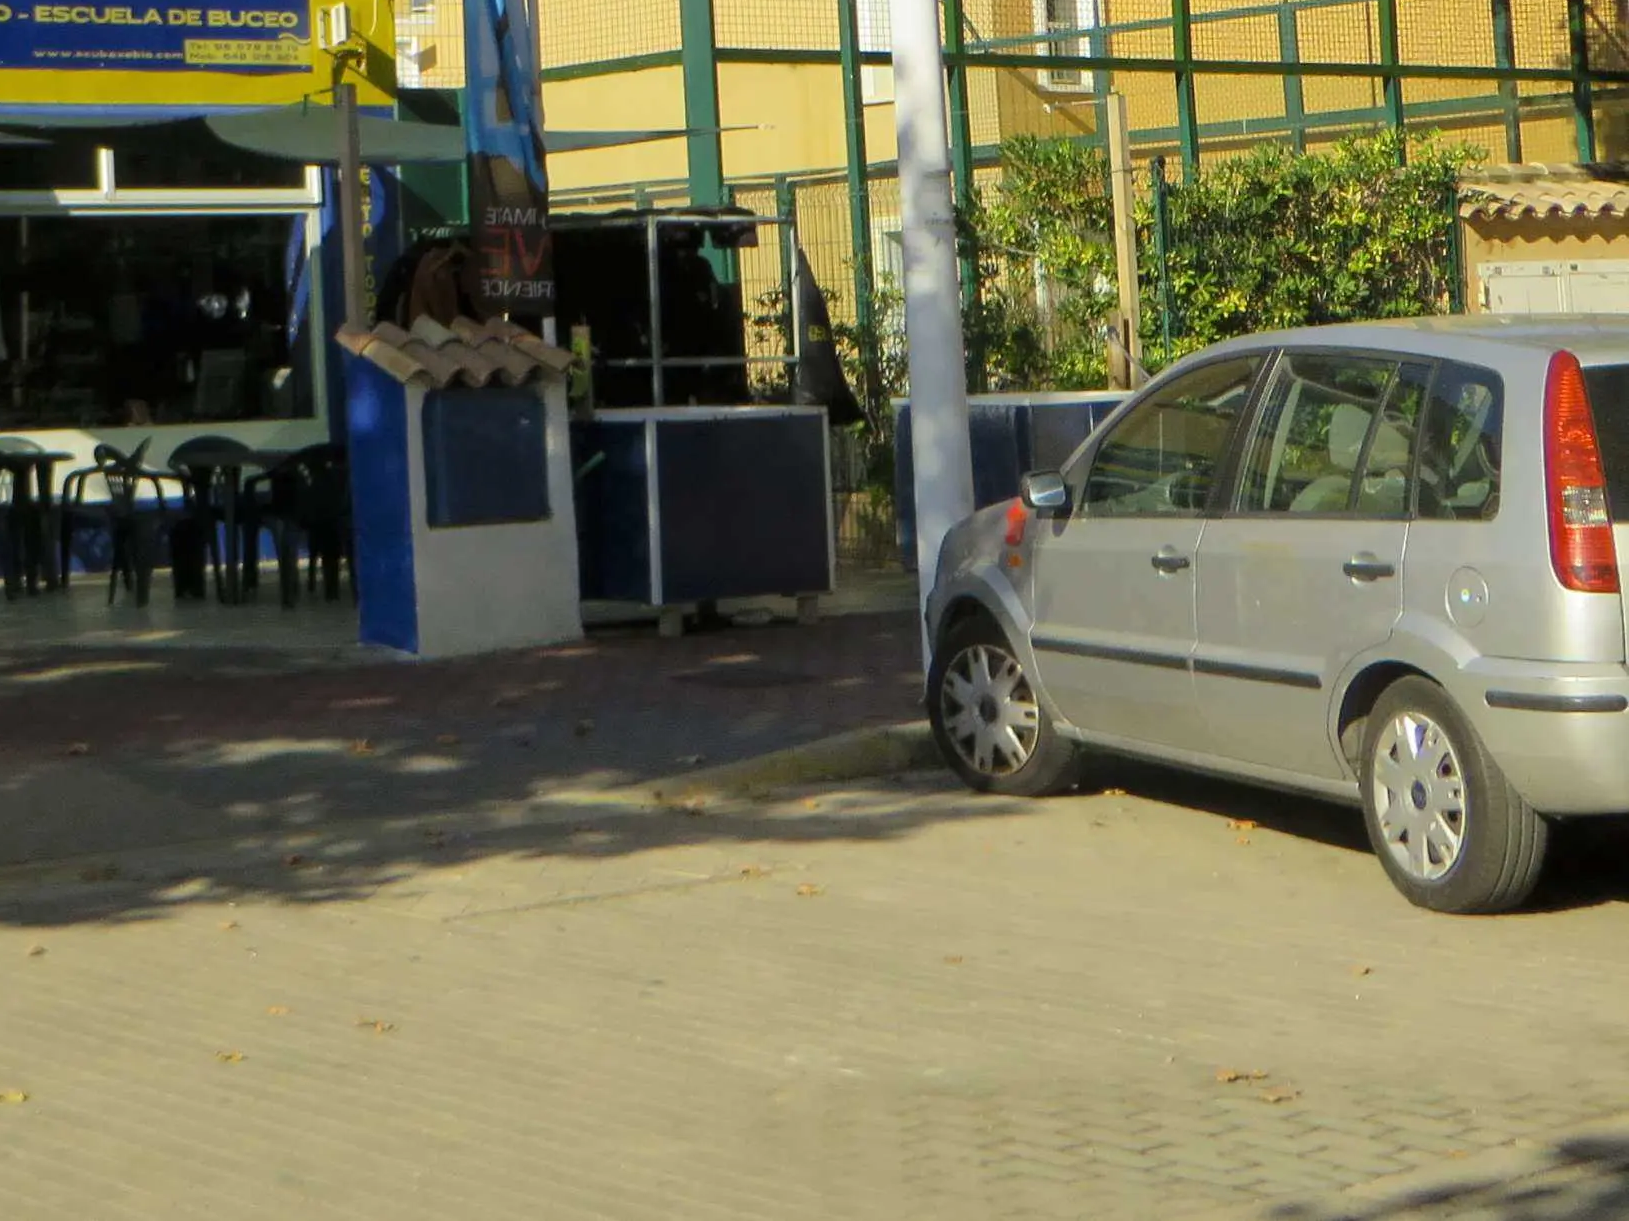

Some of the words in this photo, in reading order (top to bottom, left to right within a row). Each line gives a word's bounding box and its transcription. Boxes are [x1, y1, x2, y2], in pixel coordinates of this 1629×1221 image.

[33, 4, 163, 26] ESCUELA
[167, 8, 203, 27] DE
[205, 9, 299, 30] BUCEO
